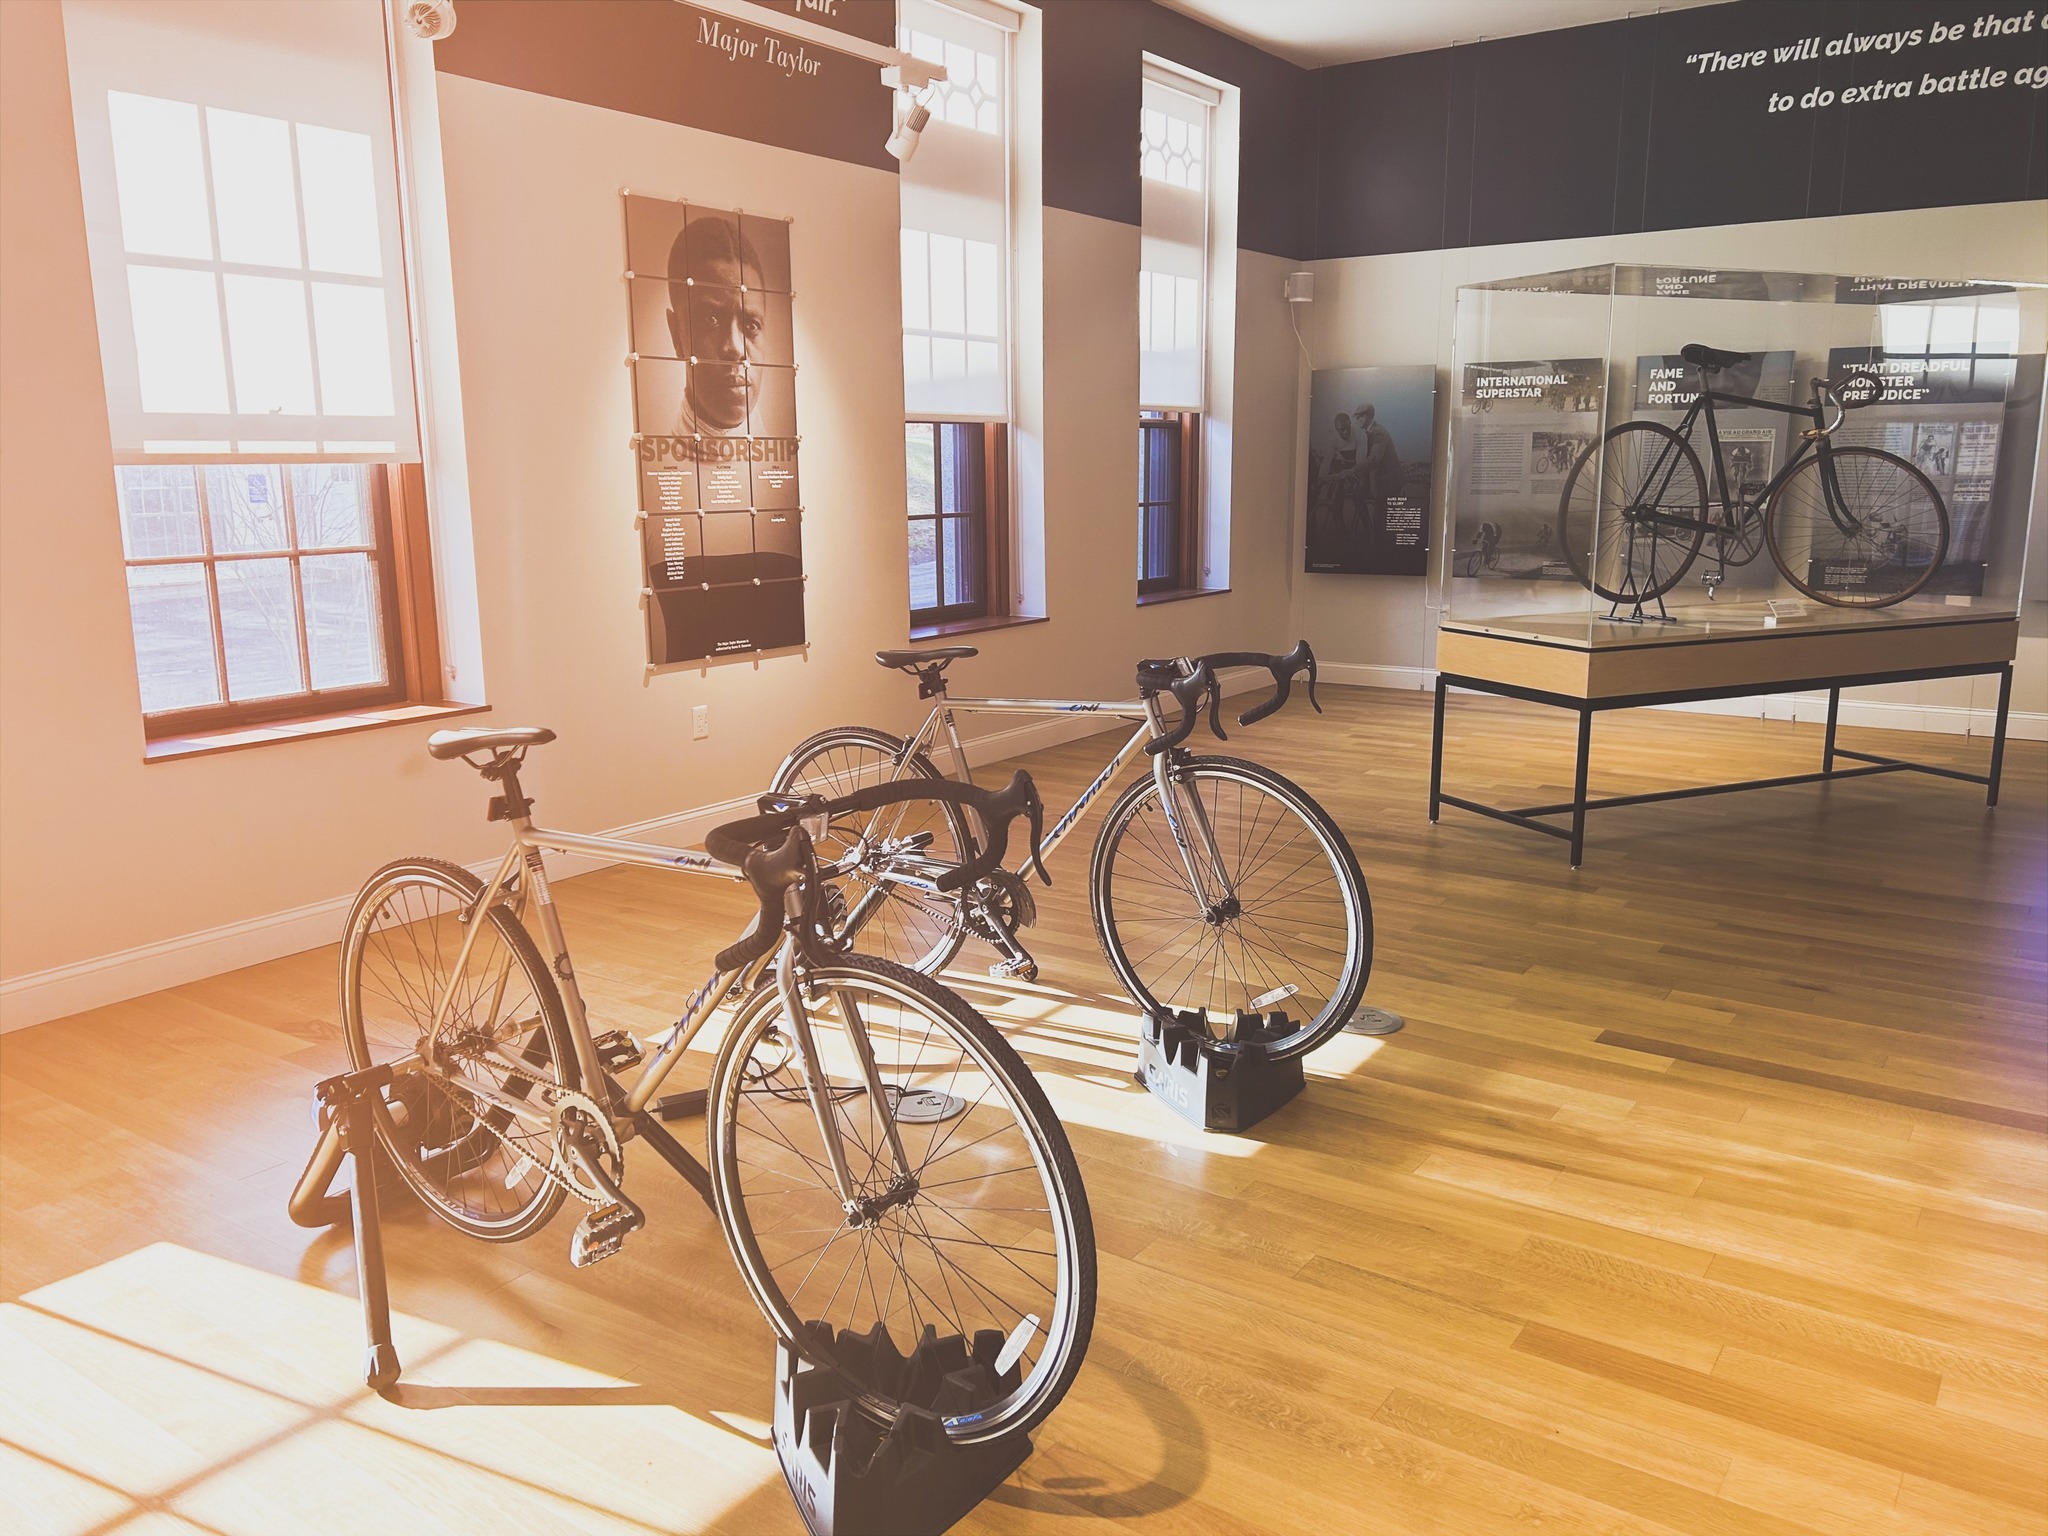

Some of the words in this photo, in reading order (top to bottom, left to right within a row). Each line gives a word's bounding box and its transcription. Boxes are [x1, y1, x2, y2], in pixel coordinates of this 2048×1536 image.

[697, 16, 758, 61] Major
[764, 37, 821, 77] Taylor
[1686, 49, 1767, 74] “There
[1773, 37, 1820, 63] will
[1824, 29, 1923, 56] always
[1928, 21, 1965, 44] be
[1972, 10, 2035, 38] that
[1768, 93, 1794, 113] to
[1800, 86, 1835, 109] do
[1841, 80, 1913, 104] extra
[1918, 66, 2008, 96] battle
[1650, 368, 1684, 379] FAME
[1889, 360, 1971, 374] DREADFUL
[1476, 375, 1568, 387] INTERNATIONAL
[1649, 381, 1677, 392] AND
[1476, 387, 1542, 399] SUPERSTAR
[1648, 392, 1701, 404] FORTUN
[1842, 388, 1930, 402] PREUDICE”
[641, 438, 799, 463] SPONSORSHIP
[1148, 1064, 1189, 1109] SARIS
